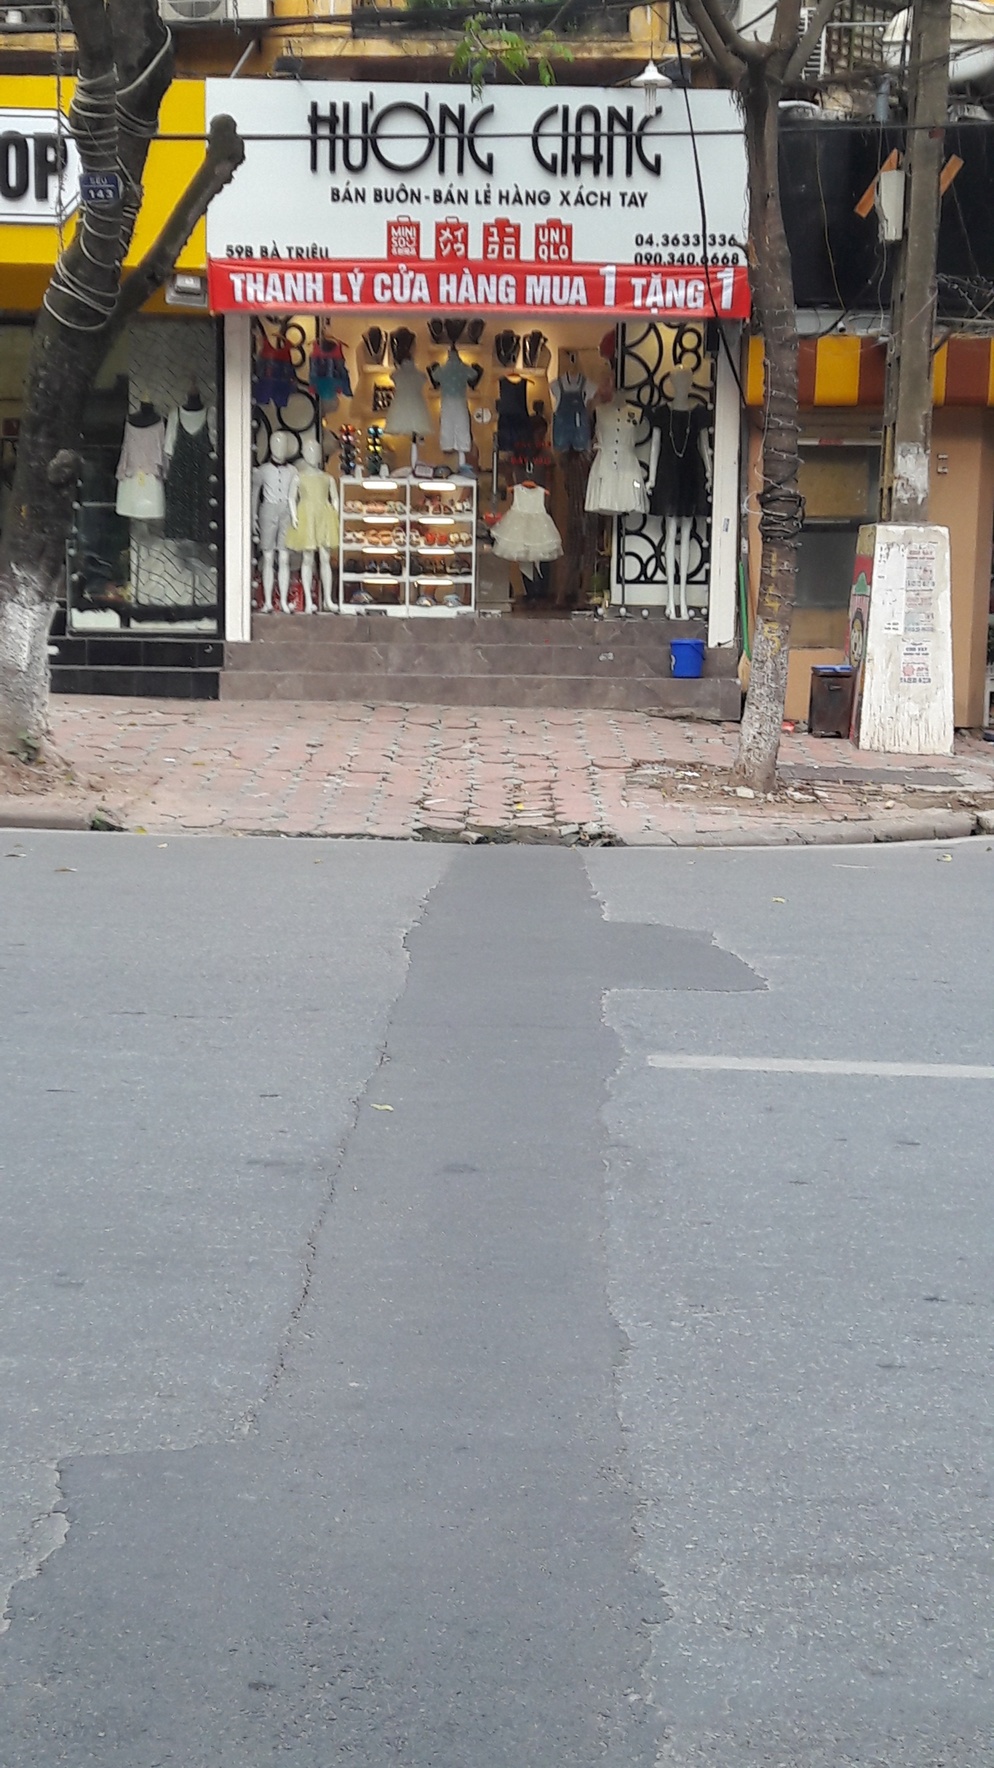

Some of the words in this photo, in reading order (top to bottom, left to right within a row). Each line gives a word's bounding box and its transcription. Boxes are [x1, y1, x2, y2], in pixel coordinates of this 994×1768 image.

[308, 92, 495, 175] HƯƠNG
[531, 103, 663, 177] GIANG
[89, 189, 113, 199] 143
[331, 180, 366, 204] BÁN
[475, 183, 491, 205] LẺ
[499, 183, 551, 206] HÀNG
[559, 184, 611, 207] XÁCH
[619, 191, 648, 208] TAY
[391, 226, 416, 238] MINI
[539, 227, 567, 244] UNI
[226, 244, 253, 258] 59B
[260, 240, 281, 259] BÀ
[538, 244, 569, 262] QLO
[229, 272, 324, 303] THANH
[332, 267, 365, 303] LÝ
[373, 263, 431, 303] CỬA
[439, 267, 516, 304] HÀNG
[525, 275, 588, 306] MUA
[599, 265, 617, 306] 1
[631, 272, 705, 314] TẶNG
[716, 267, 734, 310] 1
